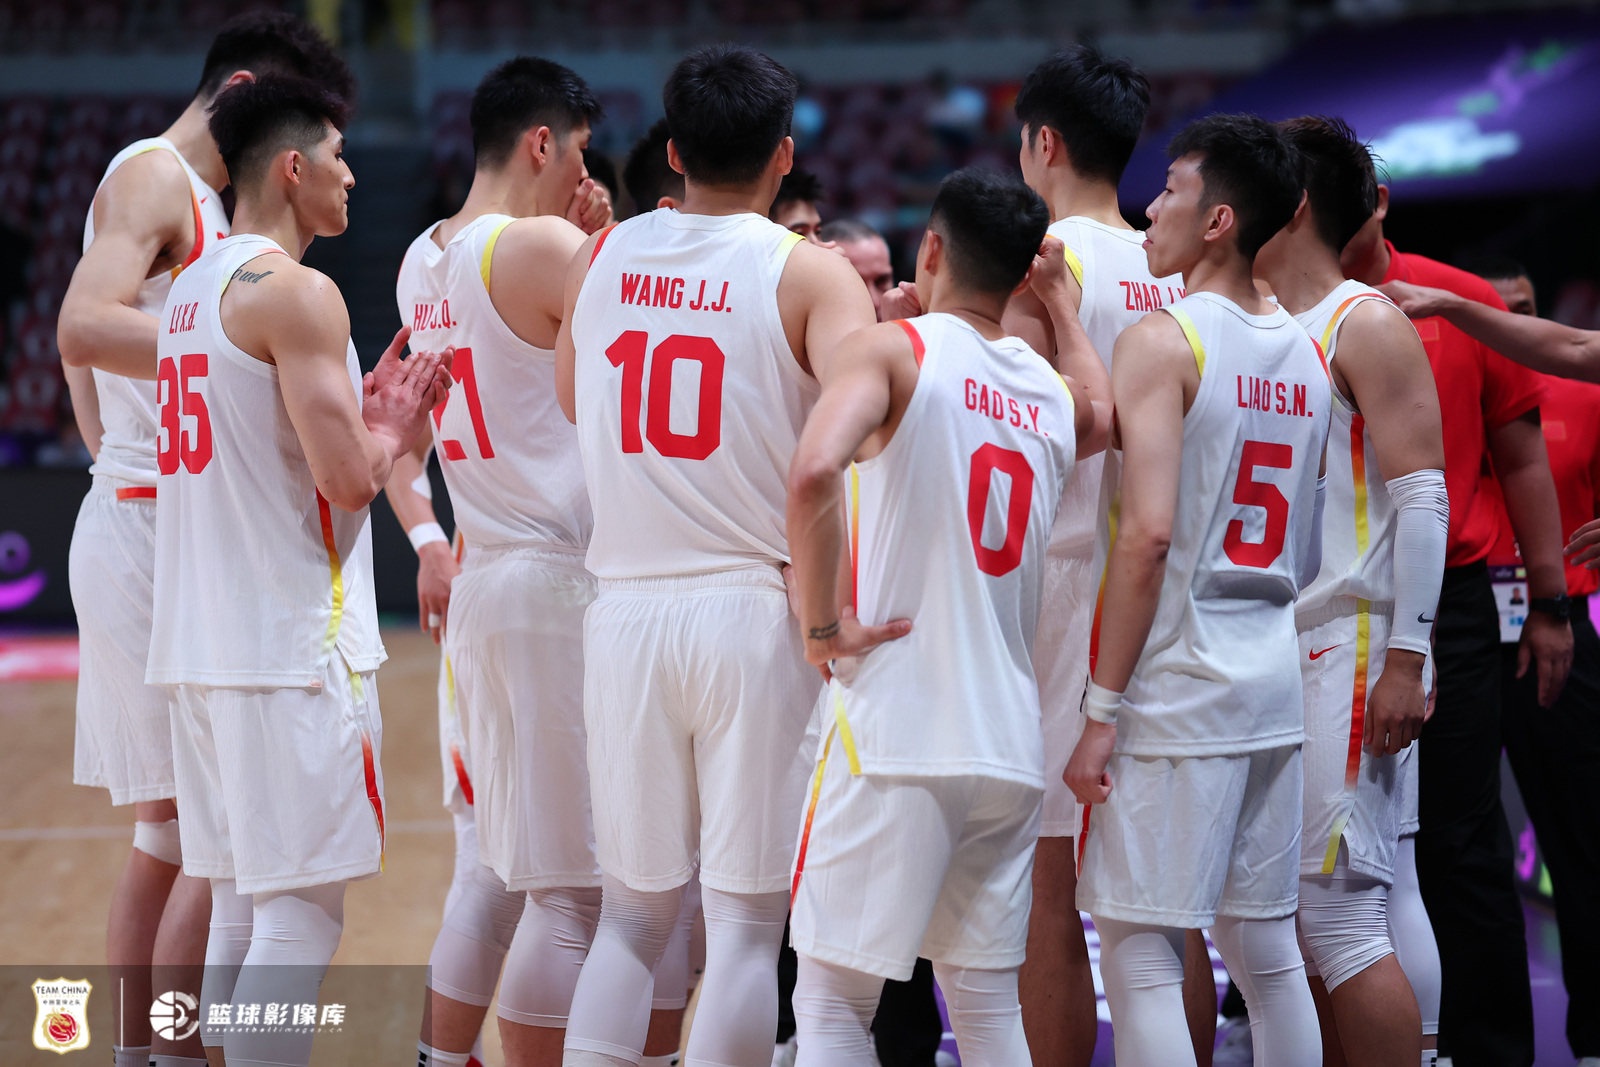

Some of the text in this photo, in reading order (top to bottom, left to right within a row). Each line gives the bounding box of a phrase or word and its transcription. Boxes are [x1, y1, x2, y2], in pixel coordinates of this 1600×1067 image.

[169, 301, 199, 334] LI X.B.
[413, 299, 457, 331] HU J.Q.
[621, 273, 732, 313] WANG J.J.
[1119, 281, 1163, 312] ZHAO
[157, 354, 213, 475] 35
[605, 330, 726, 461] 10
[964, 377, 1049, 437] GAO S.Y.
[1237, 375, 1313, 417] LIAO S.N.
[967, 441, 1035, 578] 0
[1222, 439, 1293, 569] 5
